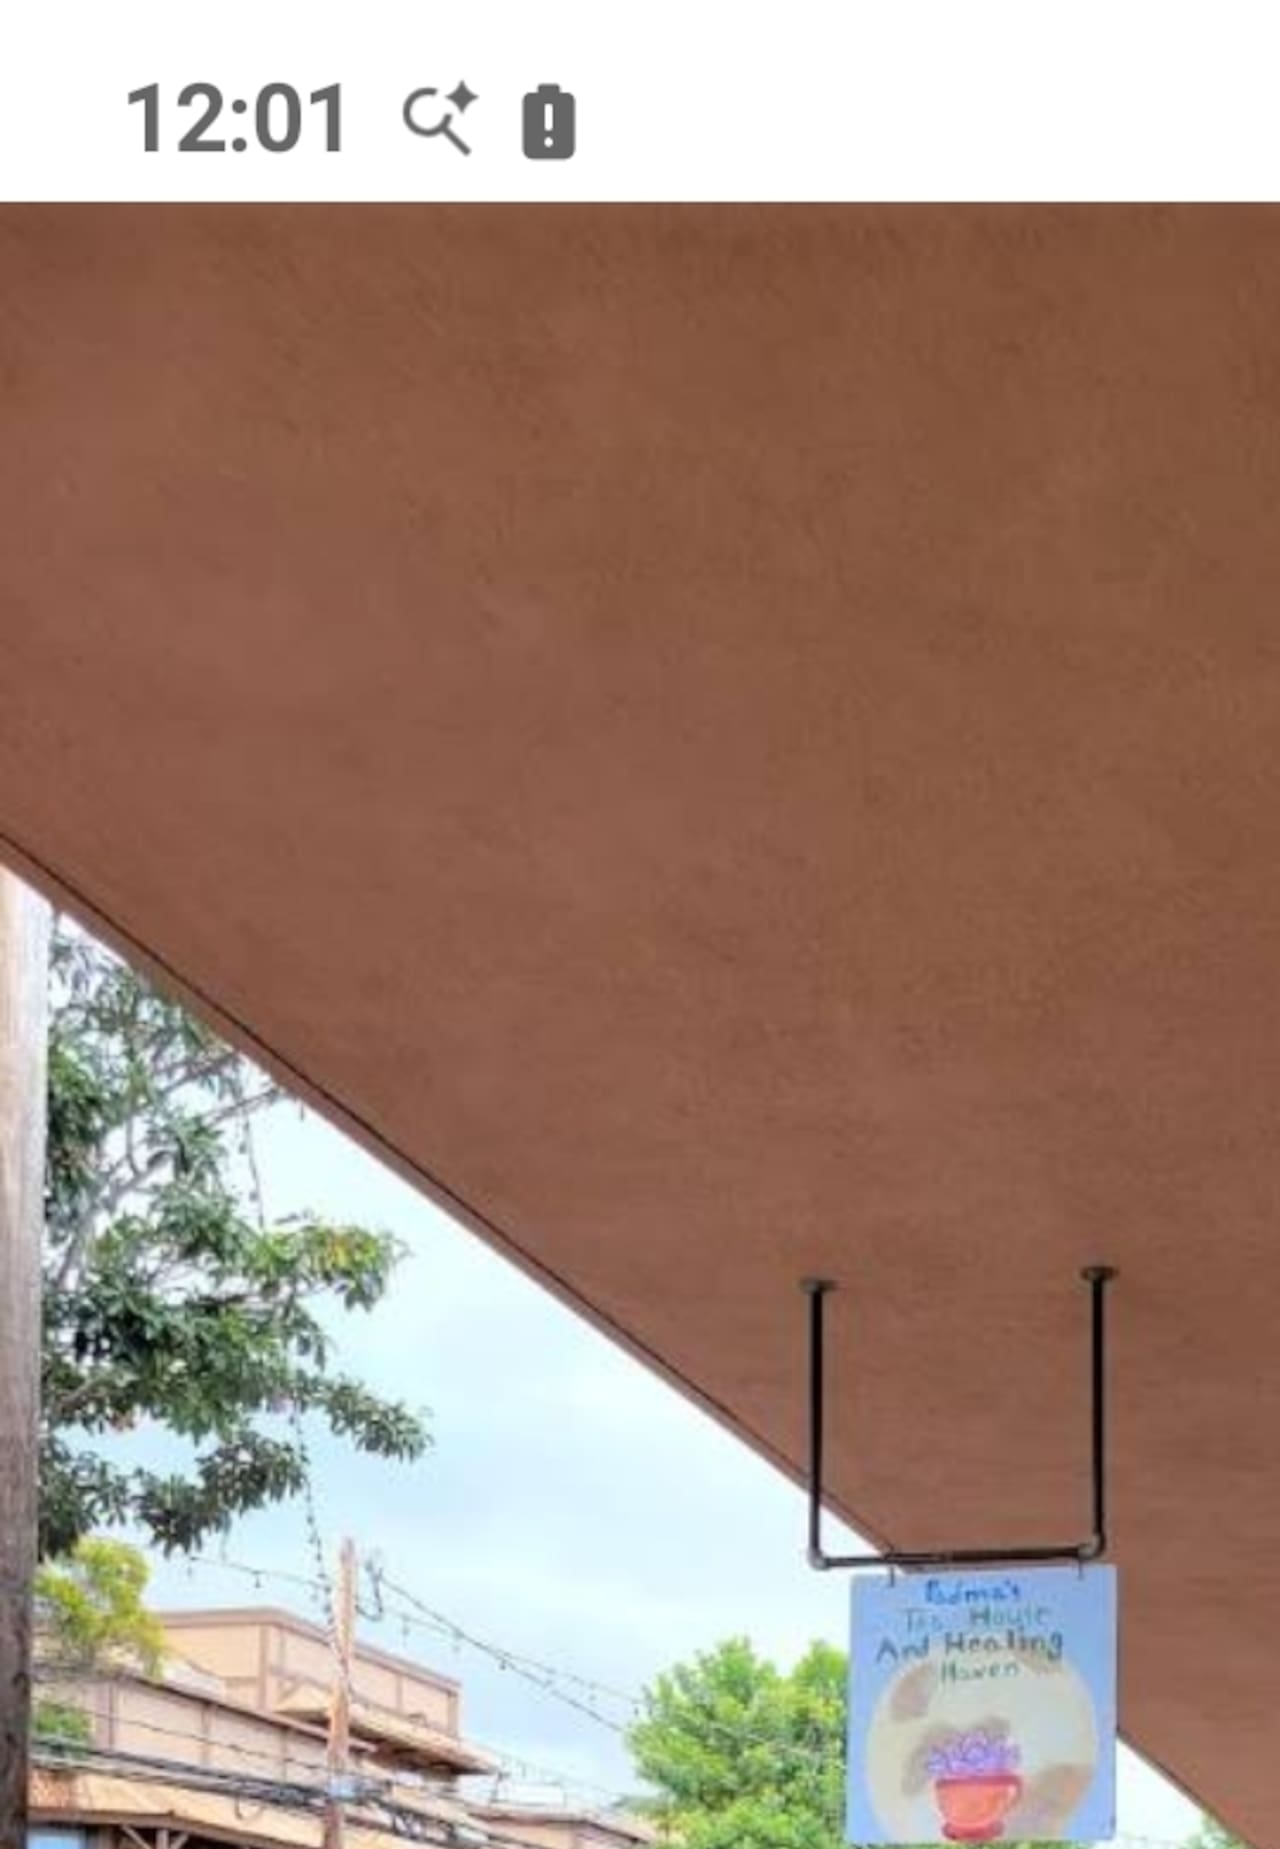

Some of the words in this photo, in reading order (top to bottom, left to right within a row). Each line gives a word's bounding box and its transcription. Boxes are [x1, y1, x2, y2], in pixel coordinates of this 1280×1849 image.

[128, 82, 341, 153] 12:01
[969, 1604, 1050, 1627] House
[876, 1634, 930, 1664] And
[945, 1626, 1063, 1660] Healing
[940, 1659, 1020, 1683] Haven
